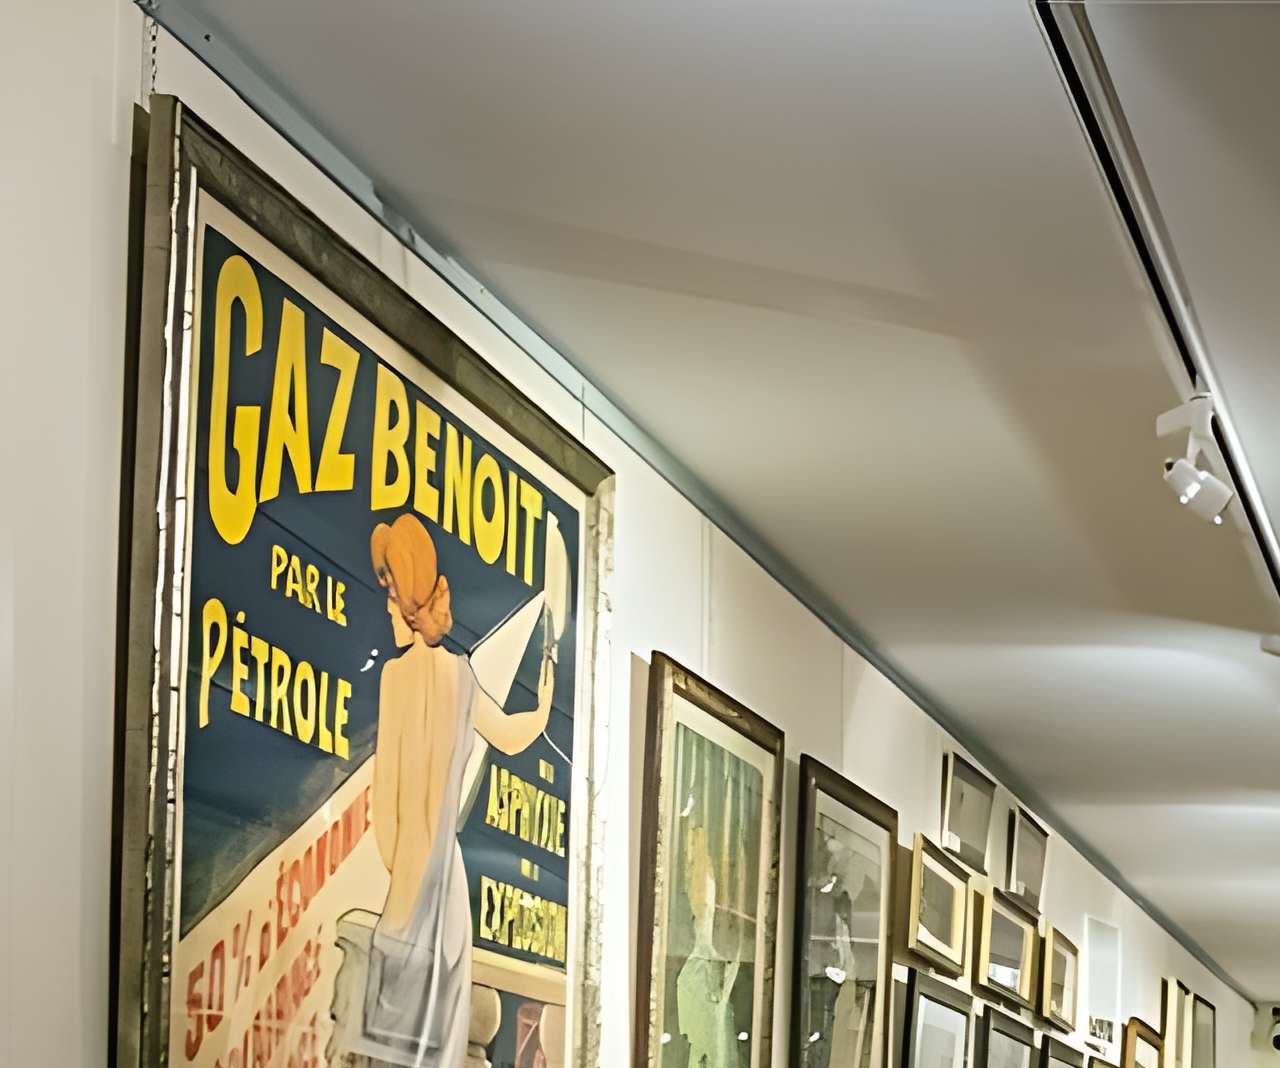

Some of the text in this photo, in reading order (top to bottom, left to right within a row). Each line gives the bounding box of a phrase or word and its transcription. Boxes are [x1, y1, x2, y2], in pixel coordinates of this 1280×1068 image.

[208, 254, 543, 587] GAZ BENOIT
[271, 544, 348, 627] PAR LE
[199, 597, 352, 761] PÉTROLE
[185, 938, 225, 1063] 50
